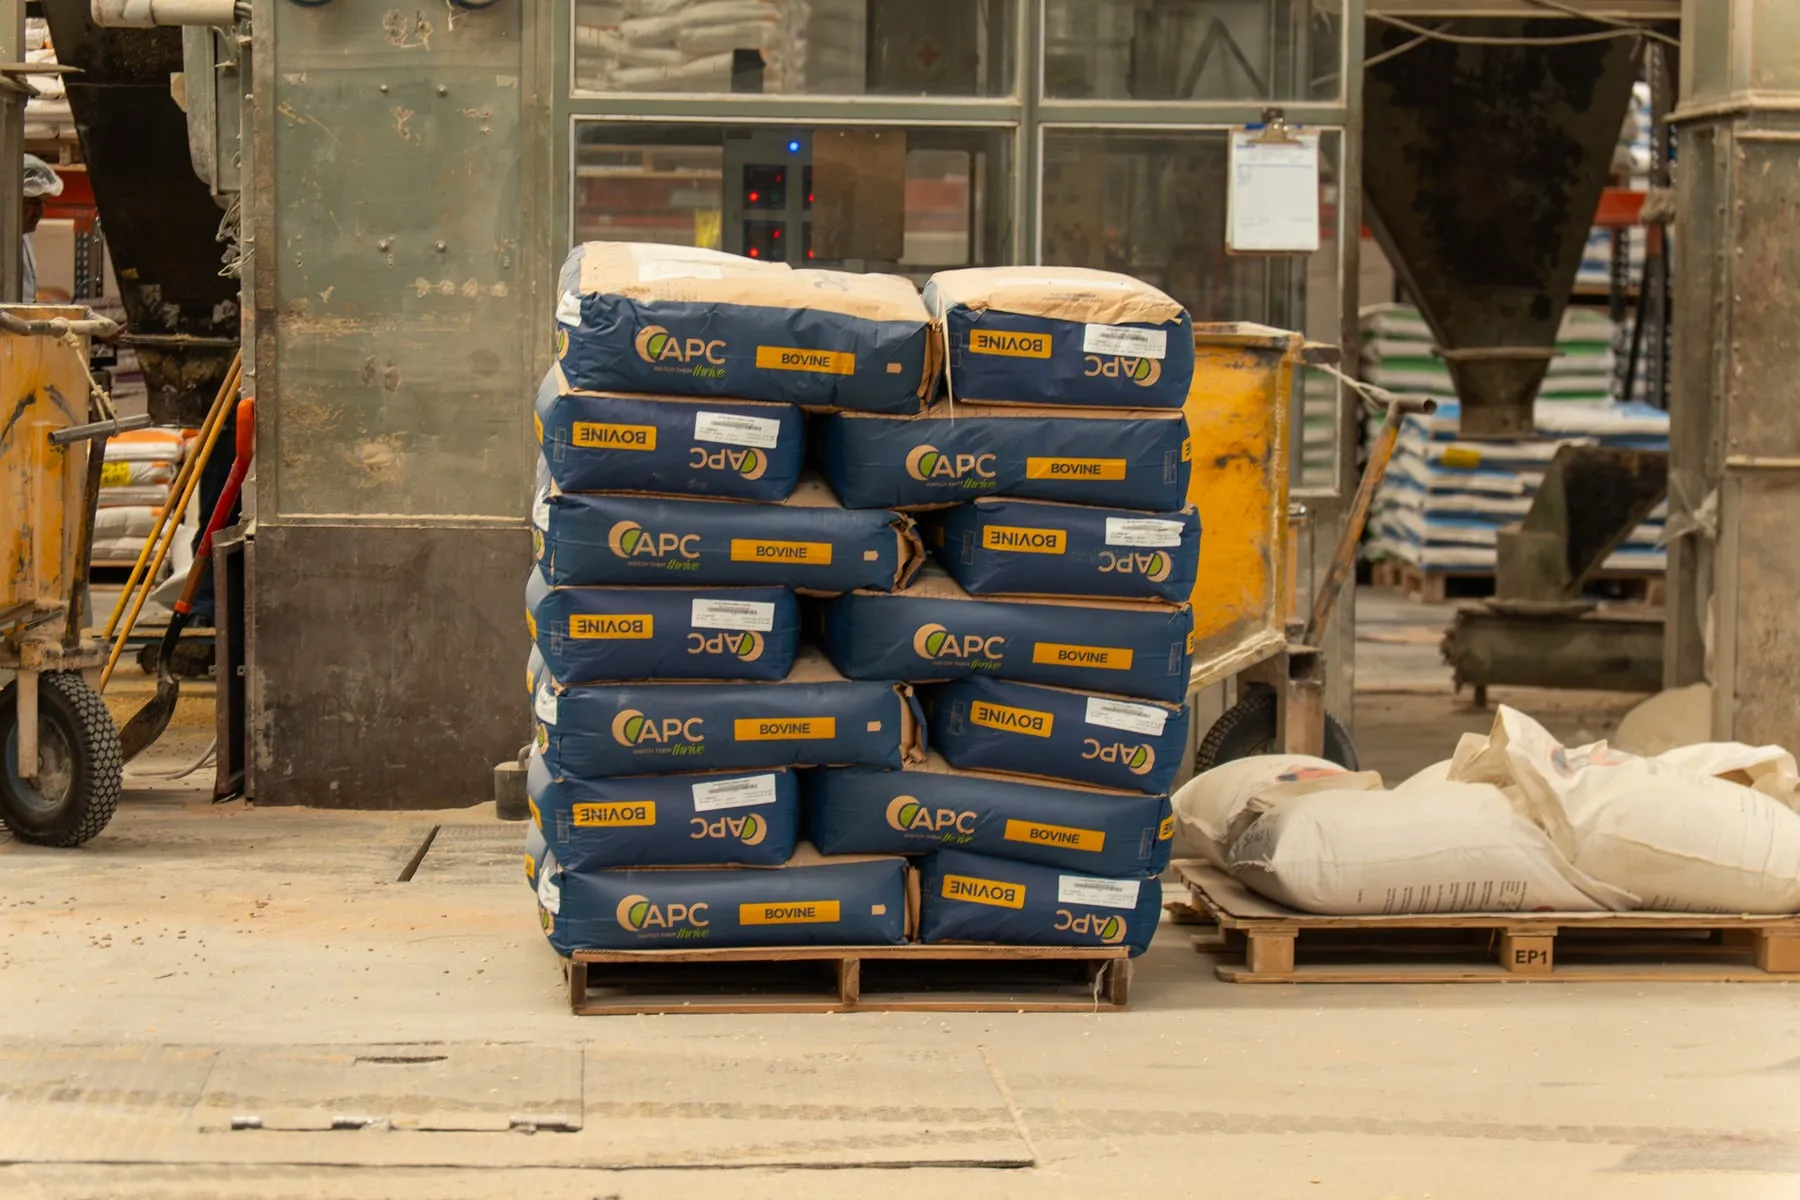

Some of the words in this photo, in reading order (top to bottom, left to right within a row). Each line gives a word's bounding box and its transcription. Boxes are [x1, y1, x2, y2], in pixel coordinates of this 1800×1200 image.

[659, 338, 726, 365] APC
[978, 334, 1042, 352] BOVINE
[781, 353, 830, 368] BOVINE
[1084, 355, 1137, 378] APC
[692, 364, 726, 378] thrive
[580, 427, 647, 444] BOVINE
[689, 447, 750, 470] APC
[929, 453, 996, 479] APC
[1050, 463, 1101, 475] BOVINE
[632, 533, 701, 559] APC
[990, 531, 1057, 548] BOVINE
[755, 545, 808, 558] BOVINE
[666, 558, 700, 571] thrive
[1097, 550, 1154, 574] APC
[577, 619, 643, 634] BOVINE
[687, 632, 748, 655] APC
[937, 635, 1004, 659] APC
[1057, 649, 1108, 664] BOVINE
[978, 707, 1043, 730] BOVINE
[637, 716, 704, 742] APC
[759, 722, 811, 735] BOVINE
[672, 743, 705, 756] thrive
[1081, 738, 1138, 763] APC
[580, 806, 646, 822] BOVINE
[909, 807, 978, 835] APC
[690, 816, 752, 838] APC
[1029, 828, 1080, 845] BOVINE
[949, 881, 1015, 902] BOVINE
[642, 903, 709, 928] APC
[764, 906, 815, 919] BOVINE
[1054, 909, 1112, 934] APC
[677, 927, 710, 940] thrive
[1515, 950, 1547, 964] EP1
